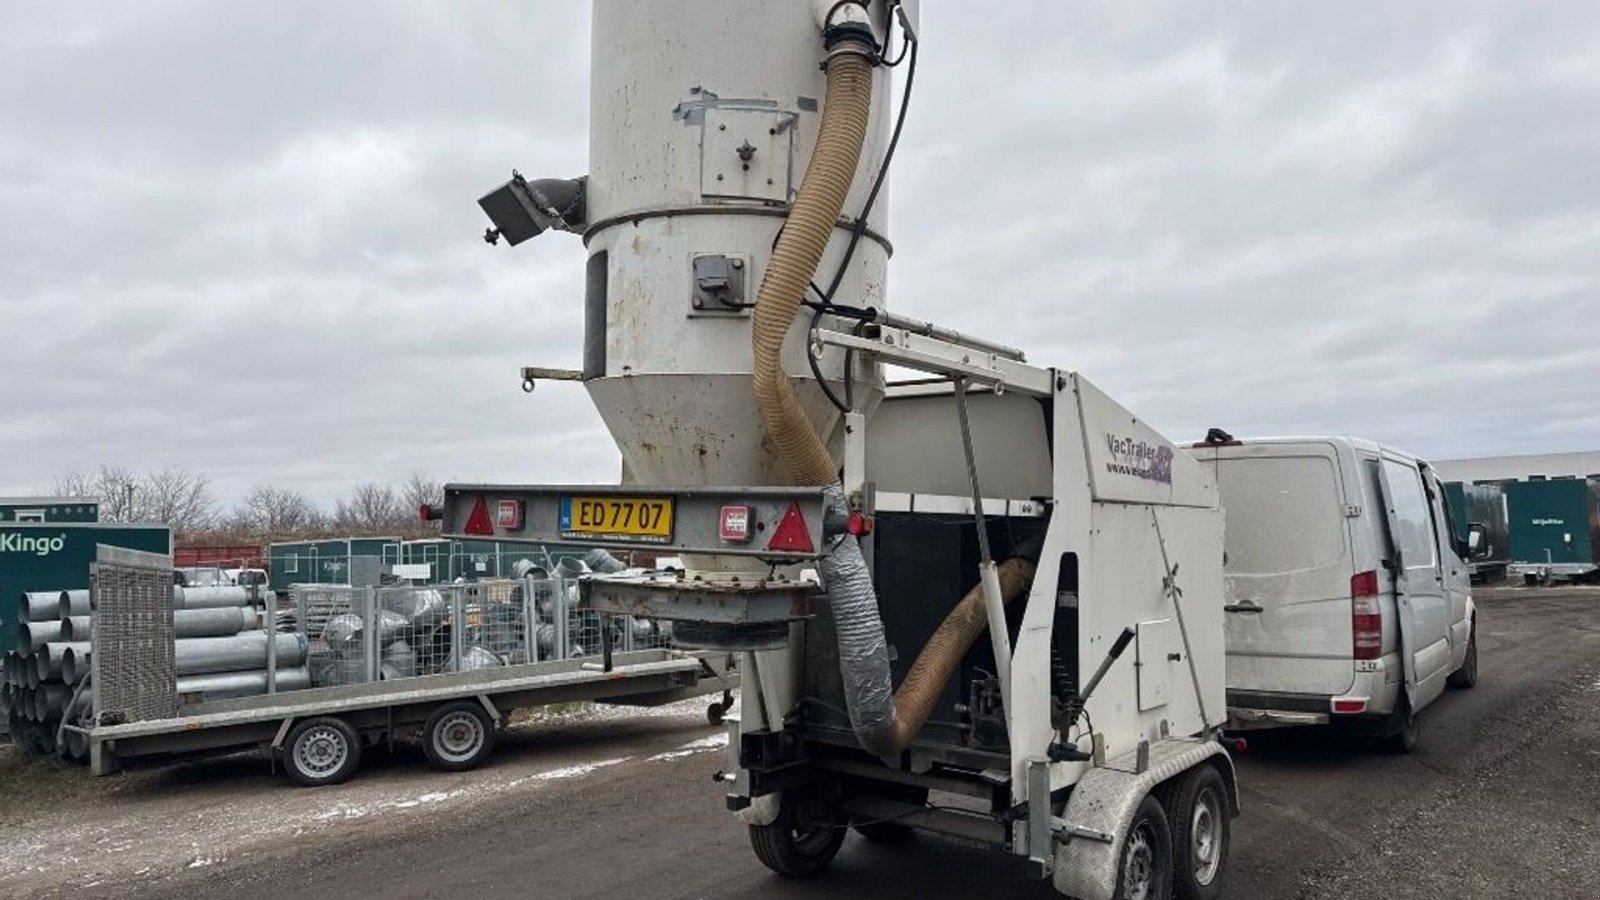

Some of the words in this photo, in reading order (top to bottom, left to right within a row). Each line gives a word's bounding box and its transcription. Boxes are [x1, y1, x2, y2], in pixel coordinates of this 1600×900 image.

[1106, 433, 1156, 460] VacTrailer
[580, 502, 605, 526] ED
[611, 503, 634, 528] 77
[639, 503, 663, 529] 07
[1, 533, 64, 556] Kingo
